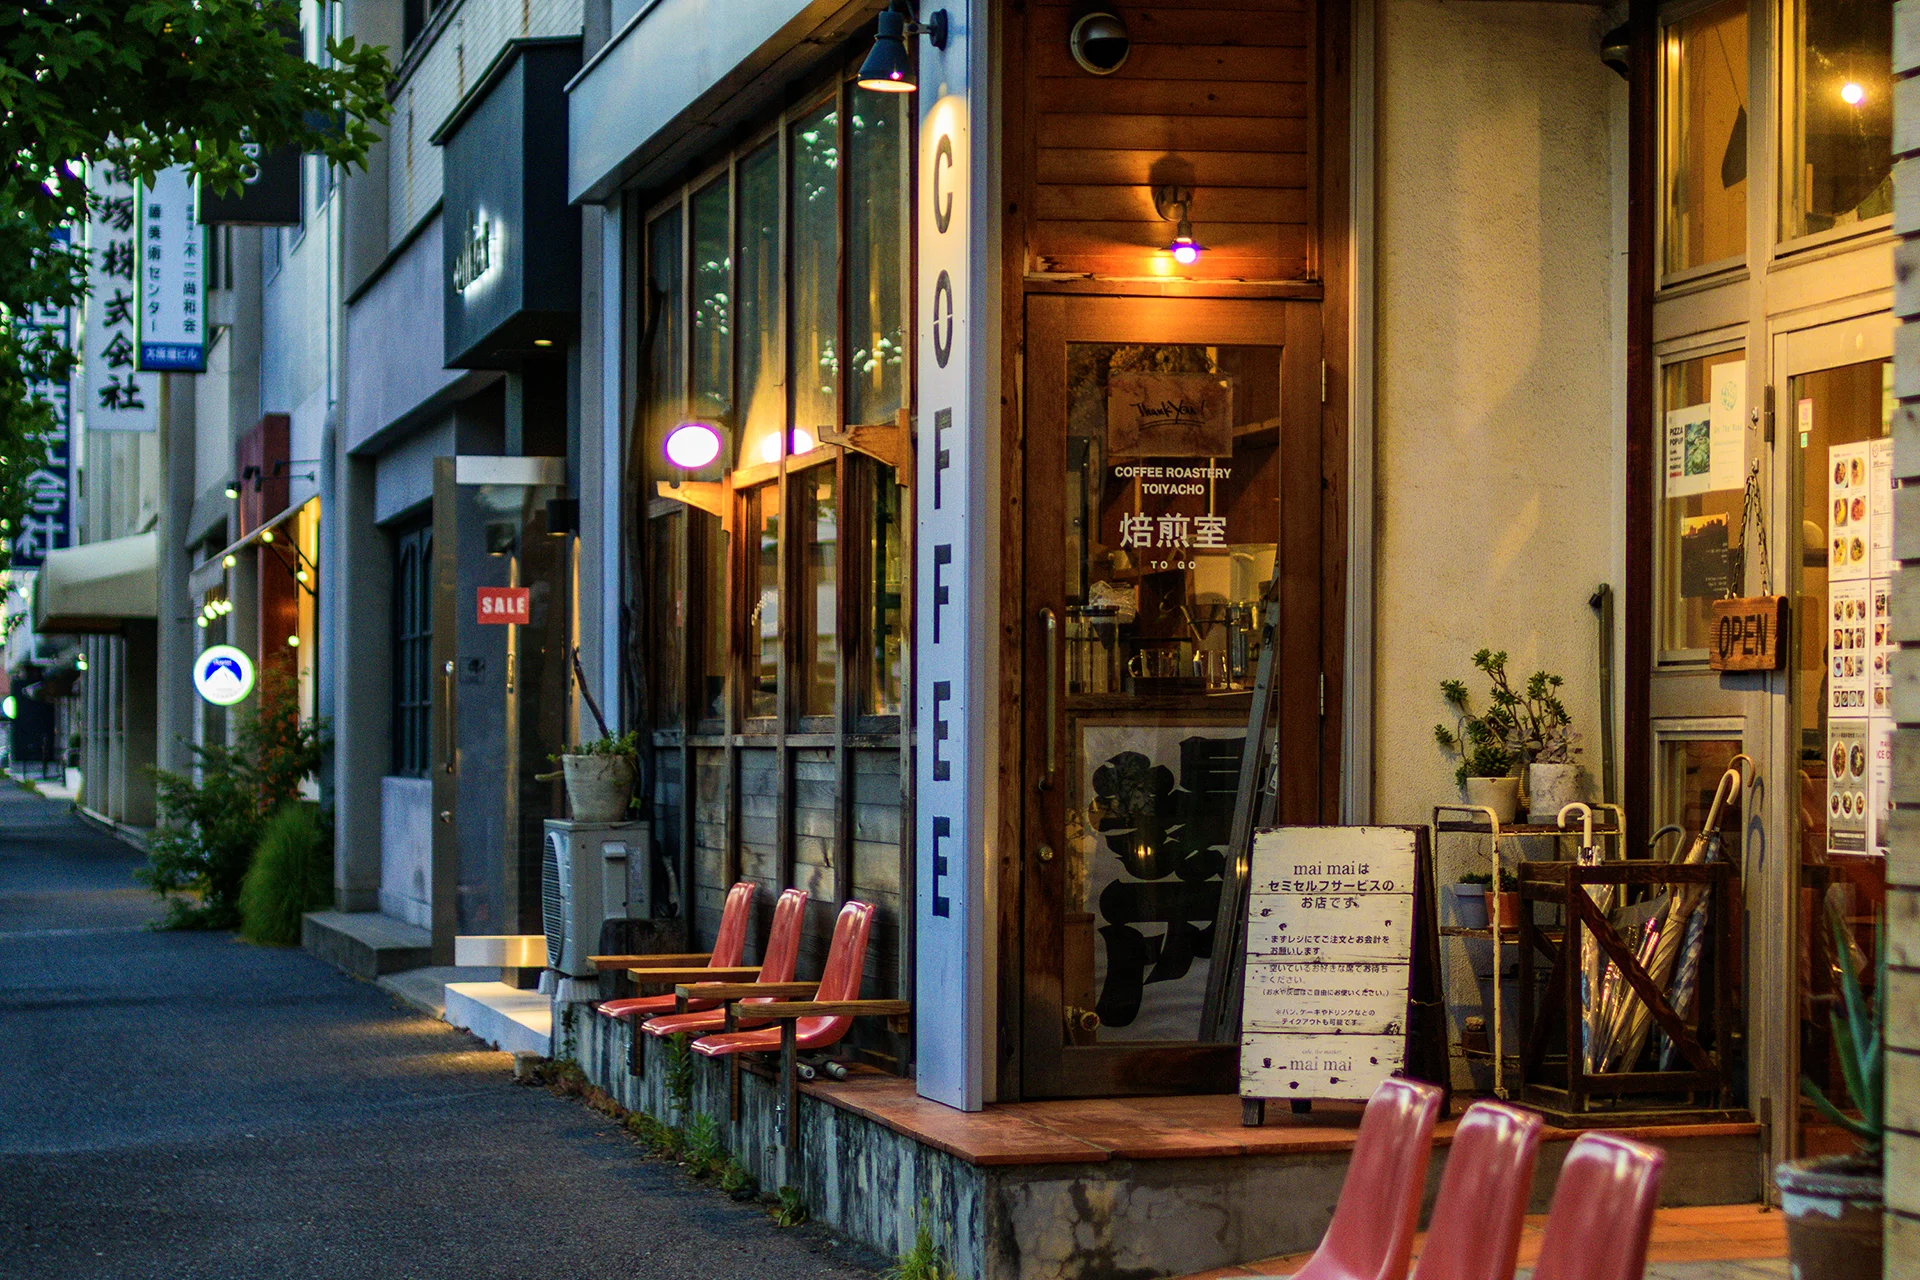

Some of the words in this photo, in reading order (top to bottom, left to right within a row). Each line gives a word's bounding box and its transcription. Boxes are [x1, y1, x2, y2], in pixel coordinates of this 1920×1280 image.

[1129, 401, 1172, 417] Thank
[1114, 466, 1163, 478] COFFEE
[1166, 467, 1232, 478] ROASTERY
[1142, 483, 1204, 495] TOIYACHO
[932, 134, 953, 917] COFFEE
[1119, 512, 1228, 549] 焙煎室
[1150, 560, 1168, 570] TO
[1177, 560, 1196, 570] GO
[481, 596, 526, 614] SALE
[1718, 612, 1768, 659] OPEN
[1293, 860, 1322, 875] mai
[1268, 880, 1395, 892] セミセルフサービスの
[1290, 1056, 1318, 1071] mai
[1323, 1056, 1352, 1071] mai
